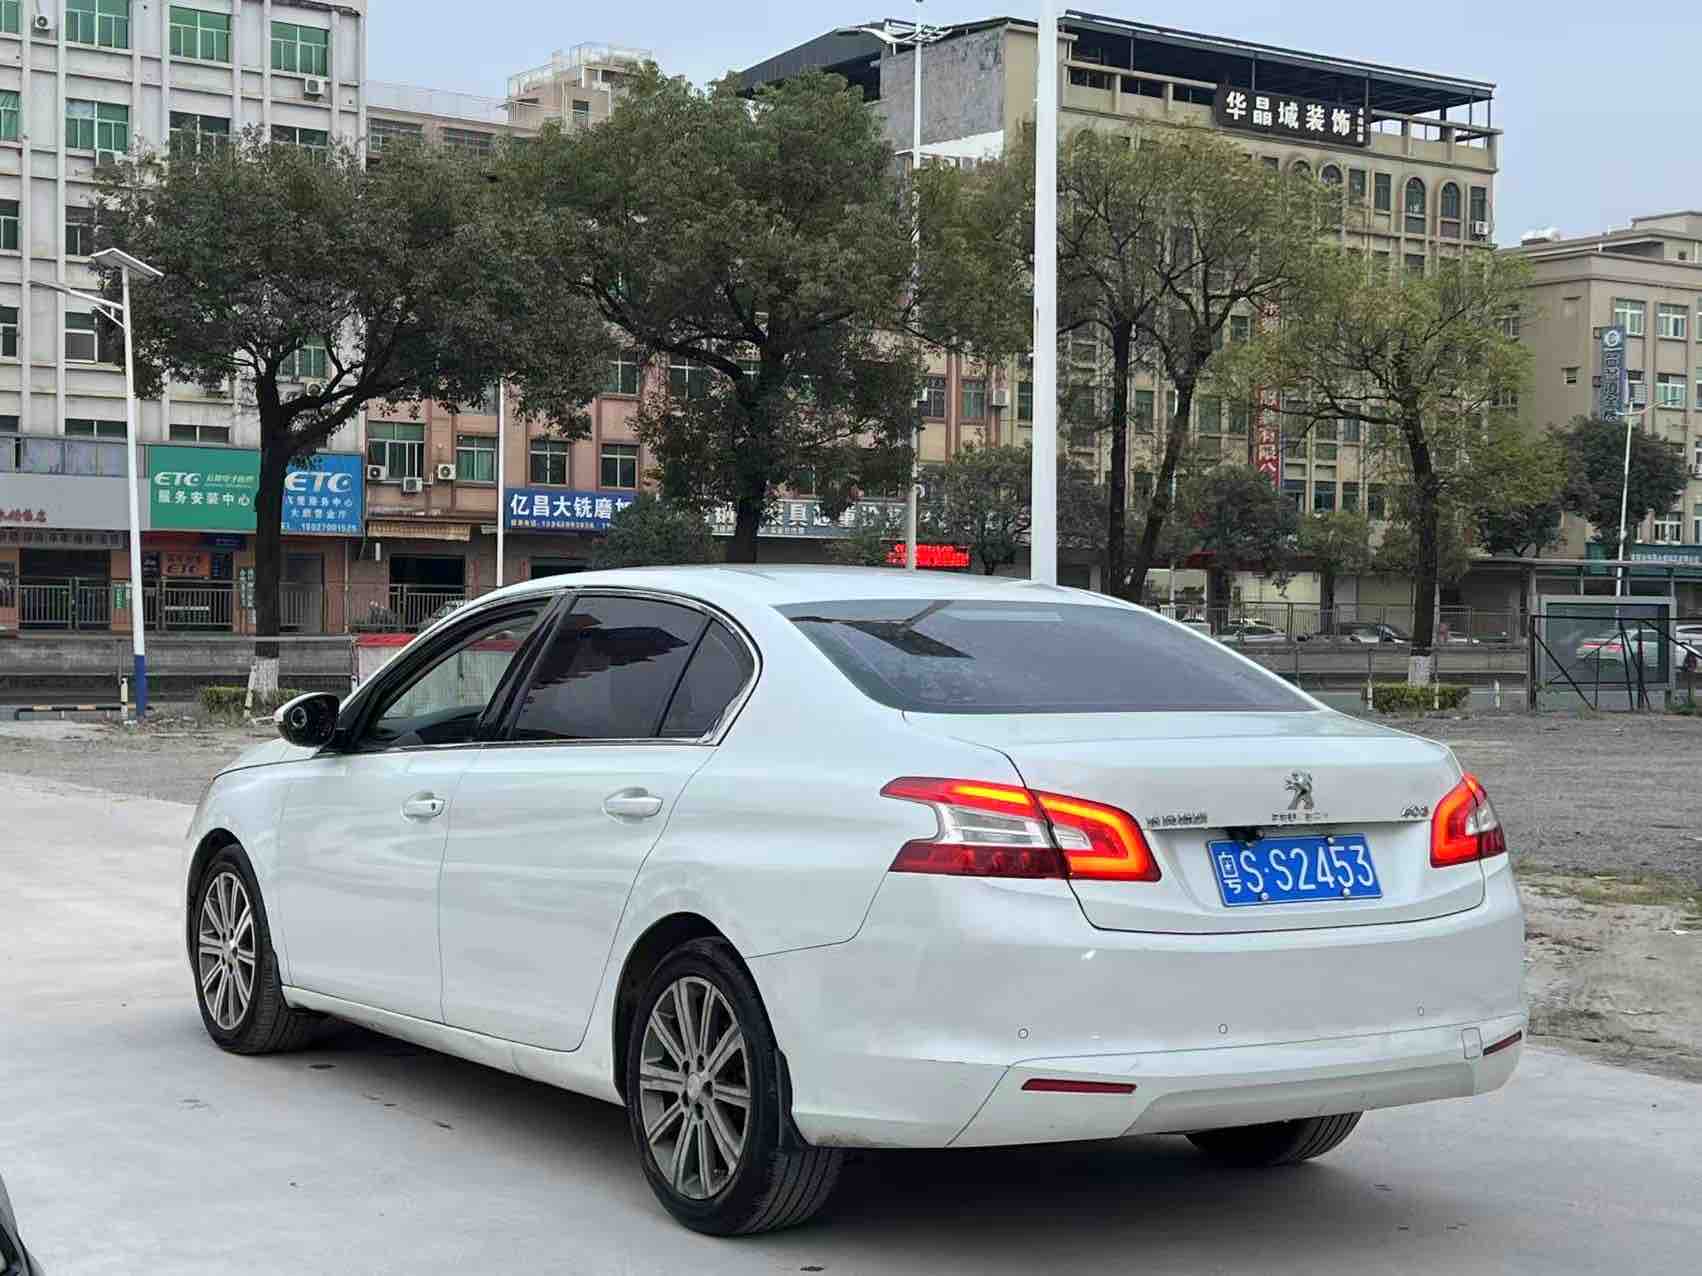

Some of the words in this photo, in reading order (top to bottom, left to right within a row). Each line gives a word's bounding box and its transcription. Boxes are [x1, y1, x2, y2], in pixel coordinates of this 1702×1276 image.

[1226, 91, 1350, 136] 华晶城装饰
[154, 472, 200, 486] ETC
[285, 471, 352, 493] ETC
